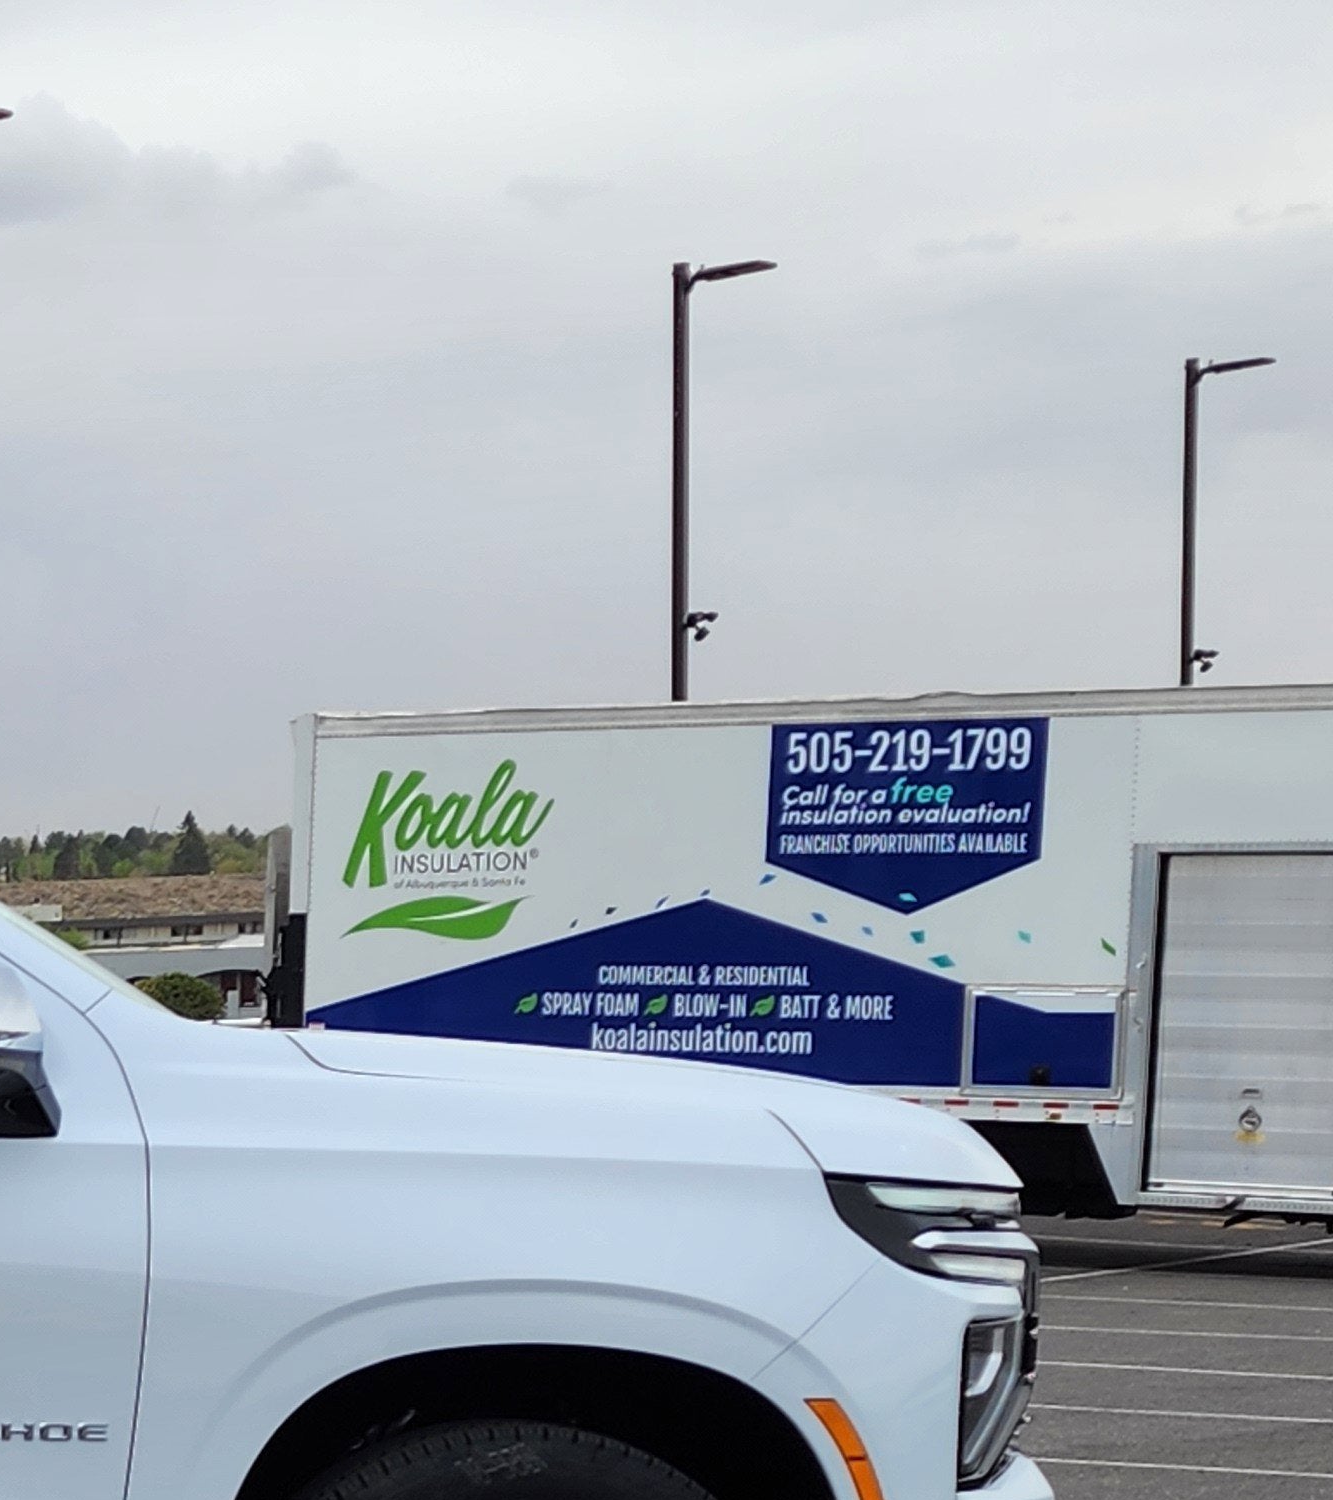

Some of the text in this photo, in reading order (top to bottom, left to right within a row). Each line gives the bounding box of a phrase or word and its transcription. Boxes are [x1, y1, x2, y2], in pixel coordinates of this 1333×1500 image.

[787, 727, 1032, 774] 505-219-1799
[783, 776, 954, 806] Call for a free
[342, 758, 554, 889] Koala
[780, 801, 1032, 826] insulation evaluation!
[780, 832, 1028, 855] FRANCHISE OPPORTUNITIES AVAILABLE
[598, 964, 810, 987] COMMERCIAL & RESIDENTIAL
[541, 992, 894, 1020] SPRAY FOAM BLOW-IN BATT & MORE
[591, 1021, 813, 1055] koalainsulation.com
